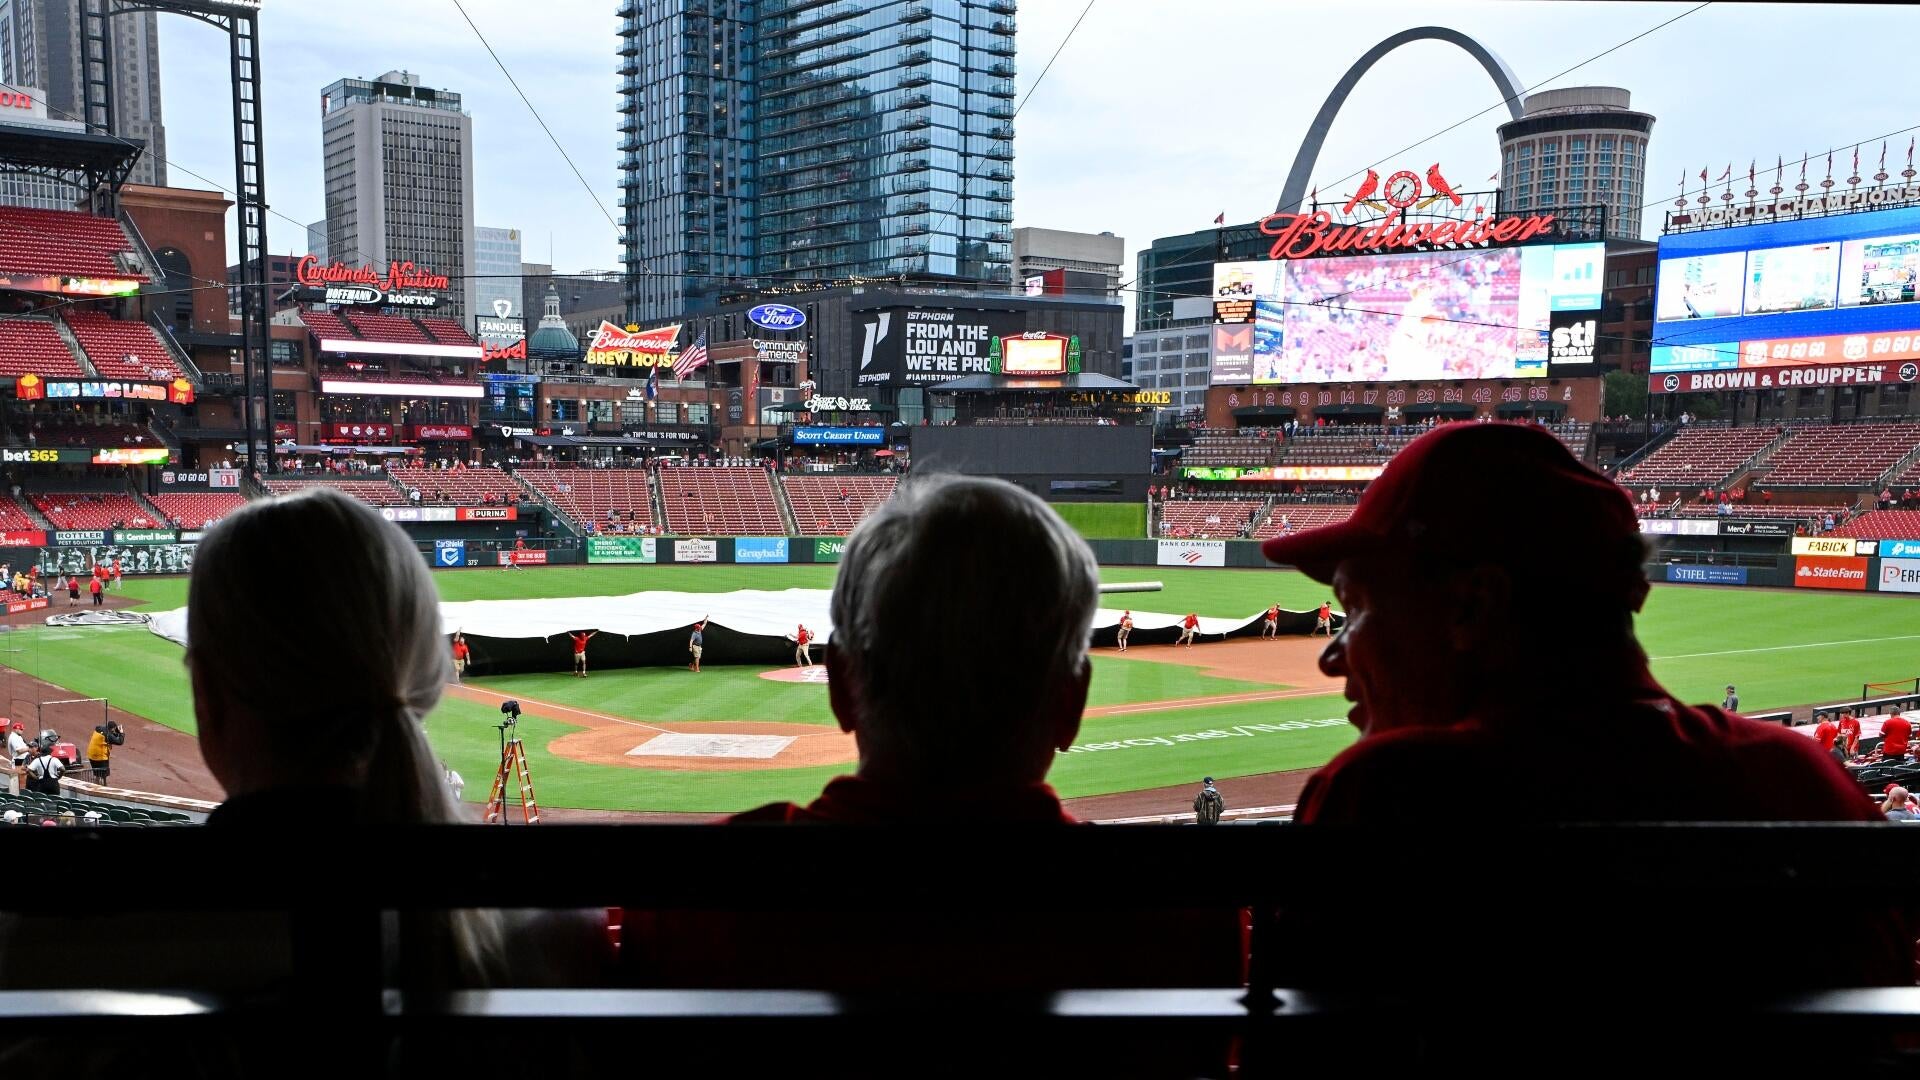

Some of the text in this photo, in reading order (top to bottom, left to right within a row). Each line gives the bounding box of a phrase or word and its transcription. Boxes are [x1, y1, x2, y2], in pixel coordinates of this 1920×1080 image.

[1689, 185, 1920, 225] WORLD CHAMPIONS
[1259, 205, 1556, 259] Budweiser
[297, 255, 449, 291] Cardinals Nation
[326, 288, 372, 300] HOFFMANN
[387, 294, 436, 306] ROOFTOP
[761, 307, 795, 326] Ford
[907, 312, 954, 321] 1ST PHORM
[480, 321, 526, 333] FANDUEL
[906, 323, 988, 340] FROM THE
[1552, 320, 1596, 347] stl
[586, 330, 679, 350] Budweiser
[753, 339, 806, 353] Community
[906, 339, 937, 354] LOU
[941, 341, 976, 355] AND
[1552, 346, 1594, 356] TODAY
[587, 351, 628, 366] BREW
[906, 355, 991, 372] WE'RE PRO
[868, 373, 890, 381] PHORM
[1666, 379, 1677, 387] BC
[1691, 366, 1882, 389] BROWN & CROUPPEN
[1122, 391, 1171, 404] SMOKE
[1265, 392, 1275, 407] 2
[1282, 391, 1292, 406] 6
[1299, 391, 1309, 406] 9
[1317, 391, 1331, 406] 10
[1340, 390, 1355, 405] 14
[1363, 390, 1379, 405] 17
[1386, 389, 1406, 404] 20
[1416, 389, 1436, 404] 23
[1443, 388, 1463, 402] 24
[1471, 387, 1492, 402] 42
[1501, 387, 1521, 401] 45
[1528, 386, 1549, 401] 85
[678, 432, 690, 440] YOU
[796, 430, 881, 441] SCOTT CREDIT UNION
[3, 449, 59, 462] bet365
[178, 473, 207, 482] GO GO GO
[221, 475, 234, 485] 91
[57, 532, 103, 540] ROTTLER
[126, 532, 153, 540] Central
[155, 532, 176, 541] Bank
[1727, 525, 1746, 534] Mercy
[436, 540, 464, 548] CarShield
[831, 543, 847, 553] Na
[1807, 541, 1849, 553] FABICK
[1675, 568, 1707, 580] STIFEL
